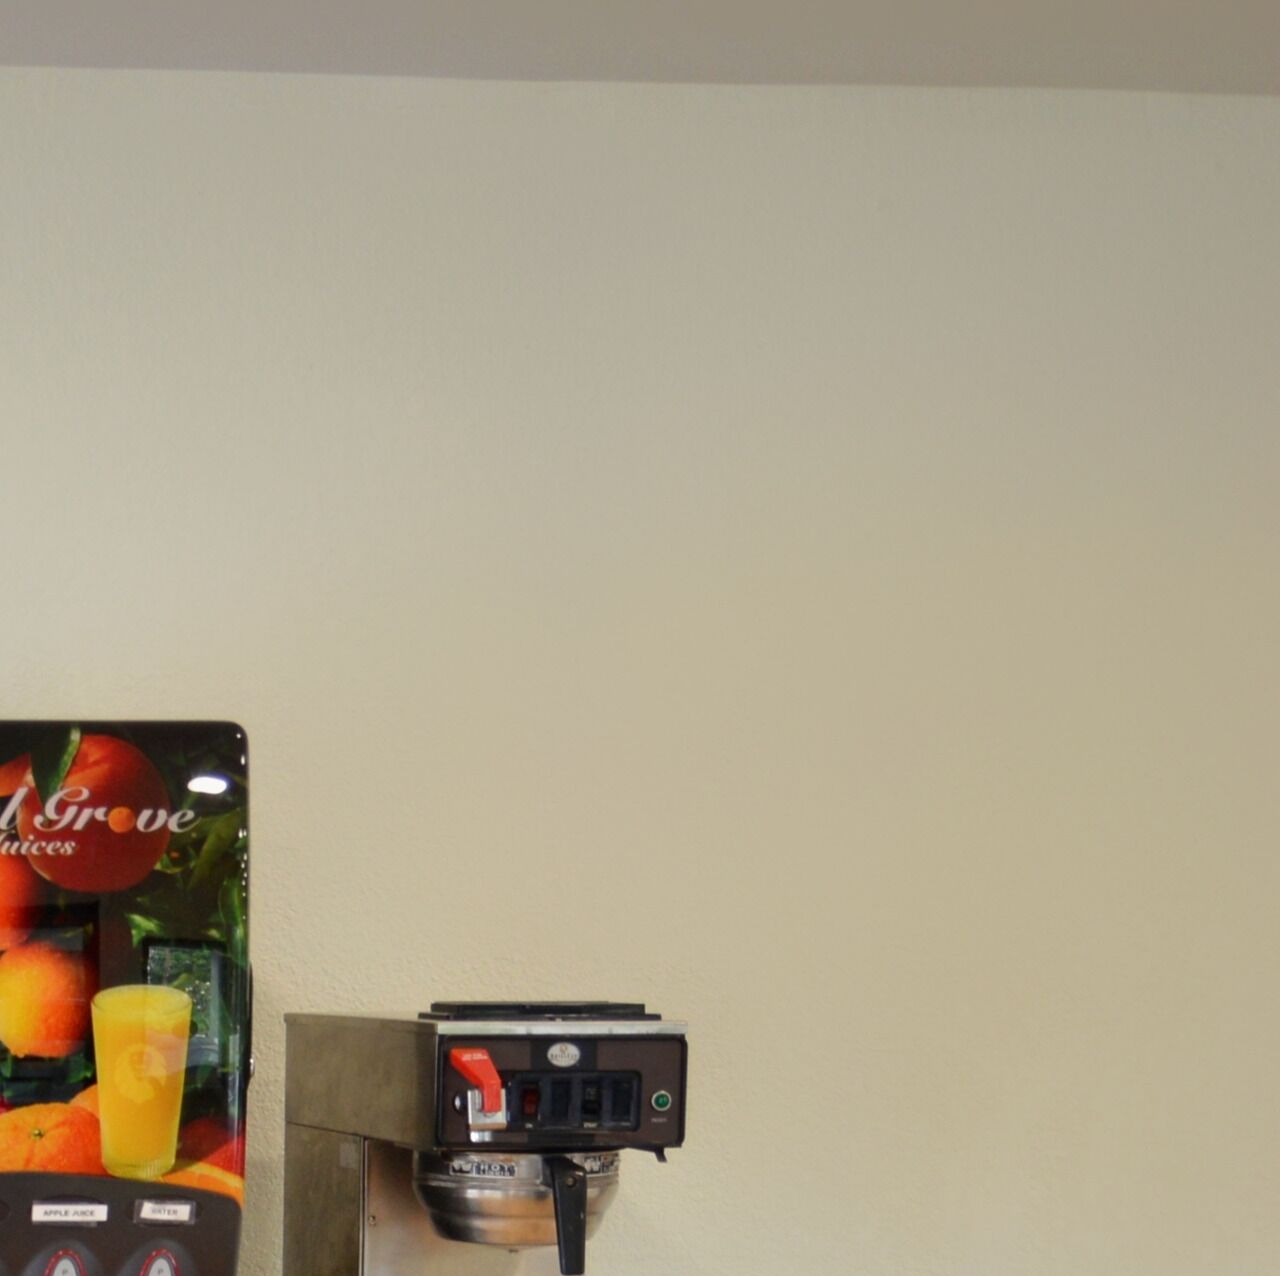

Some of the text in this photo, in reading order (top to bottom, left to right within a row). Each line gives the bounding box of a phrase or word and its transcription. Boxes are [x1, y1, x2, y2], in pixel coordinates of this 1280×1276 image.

[32, 785, 202, 834] Grove
[43, 1209, 96, 1217] APPLE JUICE
